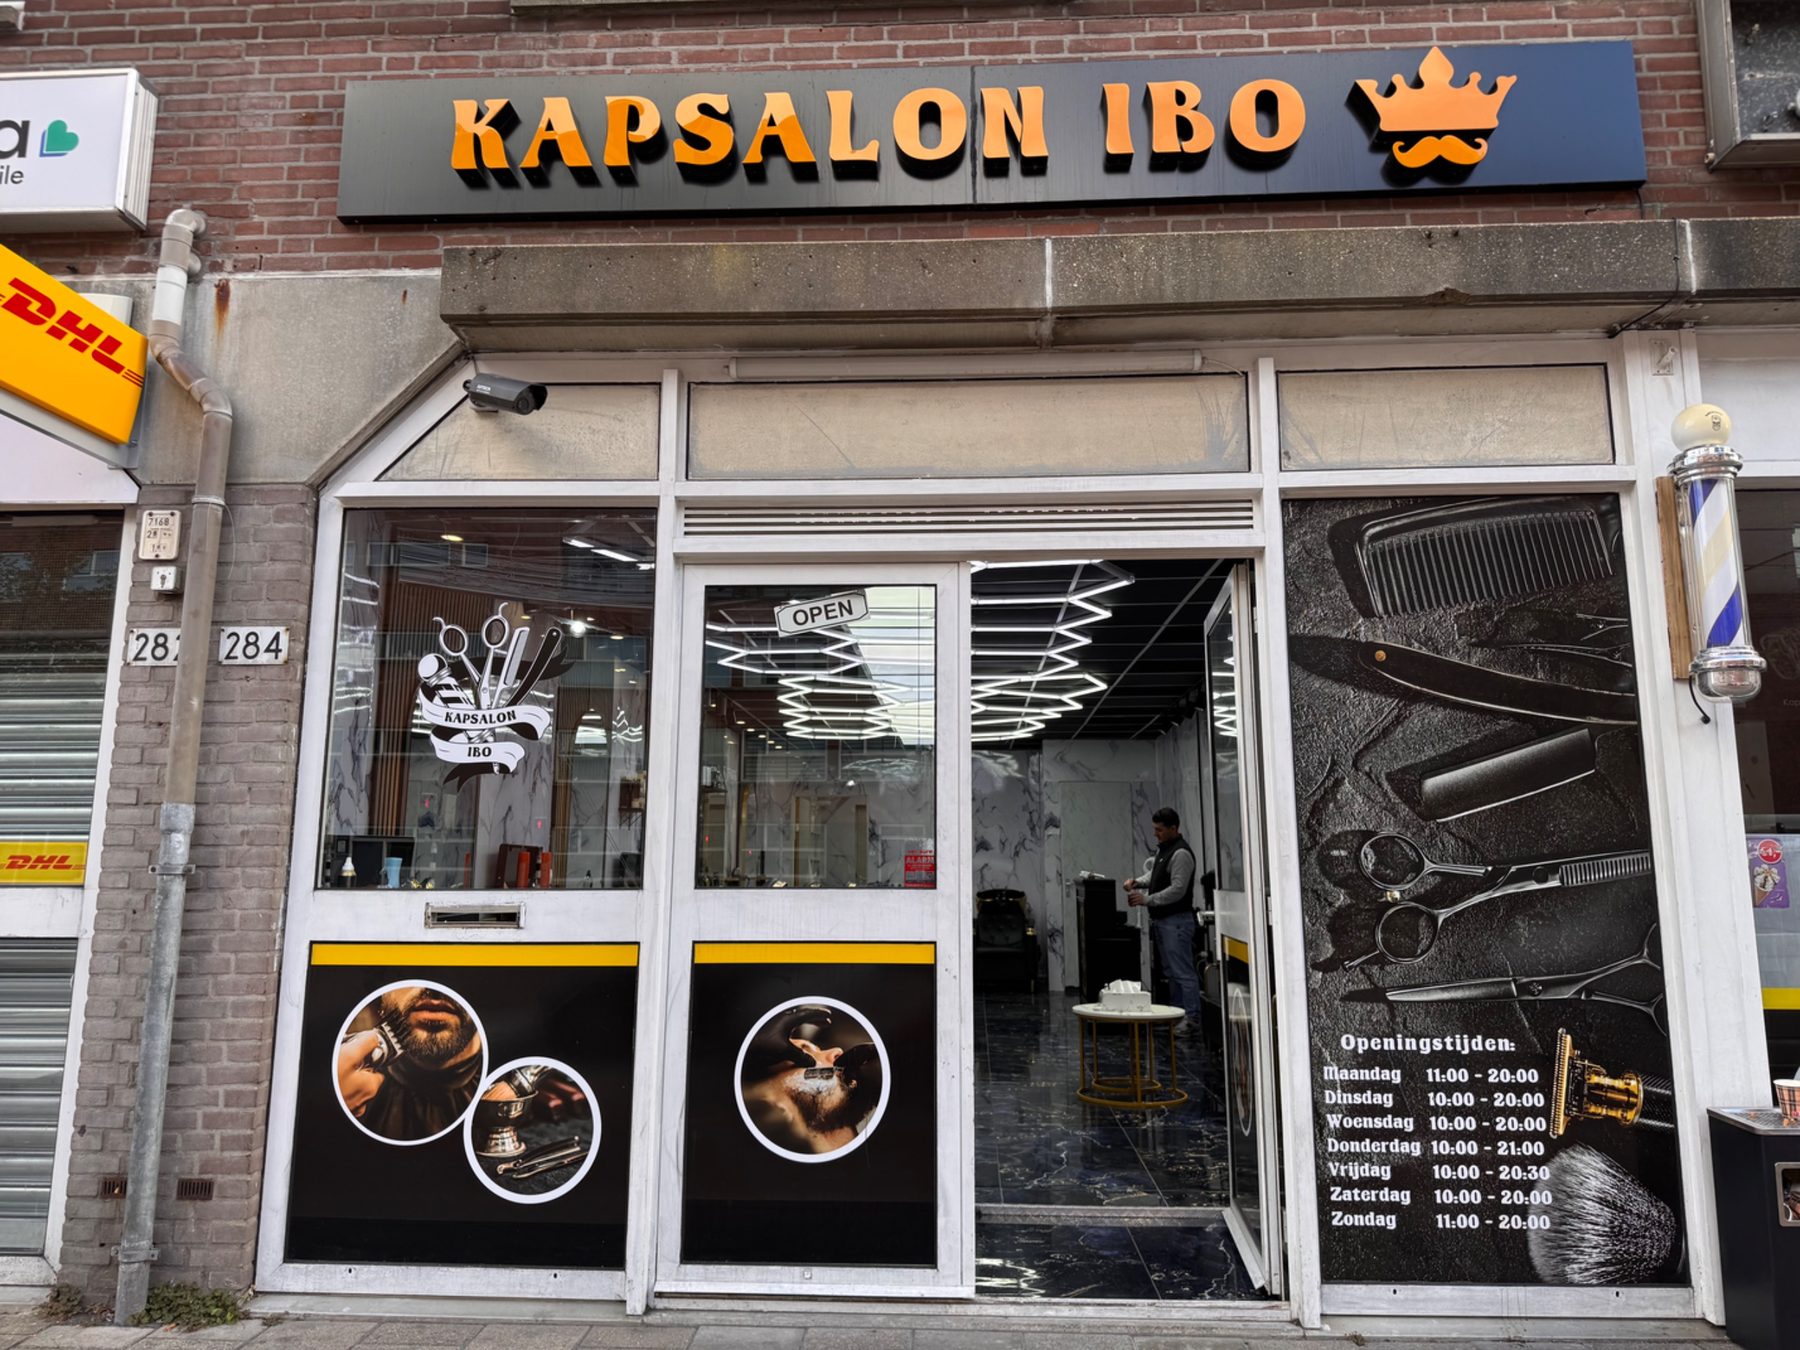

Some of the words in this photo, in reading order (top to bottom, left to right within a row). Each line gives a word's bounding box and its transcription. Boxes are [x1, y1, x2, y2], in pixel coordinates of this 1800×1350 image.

[452, 87, 1047, 169] KAPSALON
[1104, 78, 1305, 155] IBO
[2, 277, 126, 375] DHL
[793, 599, 853, 626] OPEN
[132, 632, 181, 662] 28
[224, 631, 283, 660] 284
[444, 709, 517, 725] KAPSALON
[467, 746, 493, 758] IBO
[6, 855, 72, 870] DHL
[1340, 1033, 1516, 1055] Openingstijden:
[1323, 1066, 1402, 1084] Maandag
[1426, 1068, 1469, 1083] 11:00
[1487, 1068, 1539, 1083] 20:00
[1324, 1090, 1393, 1108] Dinsdag
[1428, 1092, 1475, 1107] 10:00
[1493, 1092, 1545, 1107] 20:00
[1326, 1114, 1414, 1132] Woensdag
[1429, 1116, 1477, 1131] 10:00
[1495, 1116, 1547, 1131] 20:00
[1327, 1138, 1421, 1156] Donderdag
[1431, 1140, 1478, 1155] 10:00
[1497, 1141, 1545, 1156] 21:00
[1328, 1162, 1391, 1180] Vrijdag
[1432, 1164, 1480, 1180] 10:00
[1498, 1165, 1550, 1180] 20:30
[1330, 1186, 1411, 1205] Zaterdag
[1434, 1189, 1481, 1204] 10:00
[1500, 1189, 1552, 1205] 20:00
[1331, 1211, 1396, 1230] Zondag
[1436, 1214, 1480, 1229] 11:00
[1498, 1214, 1551, 1230] 20:00
